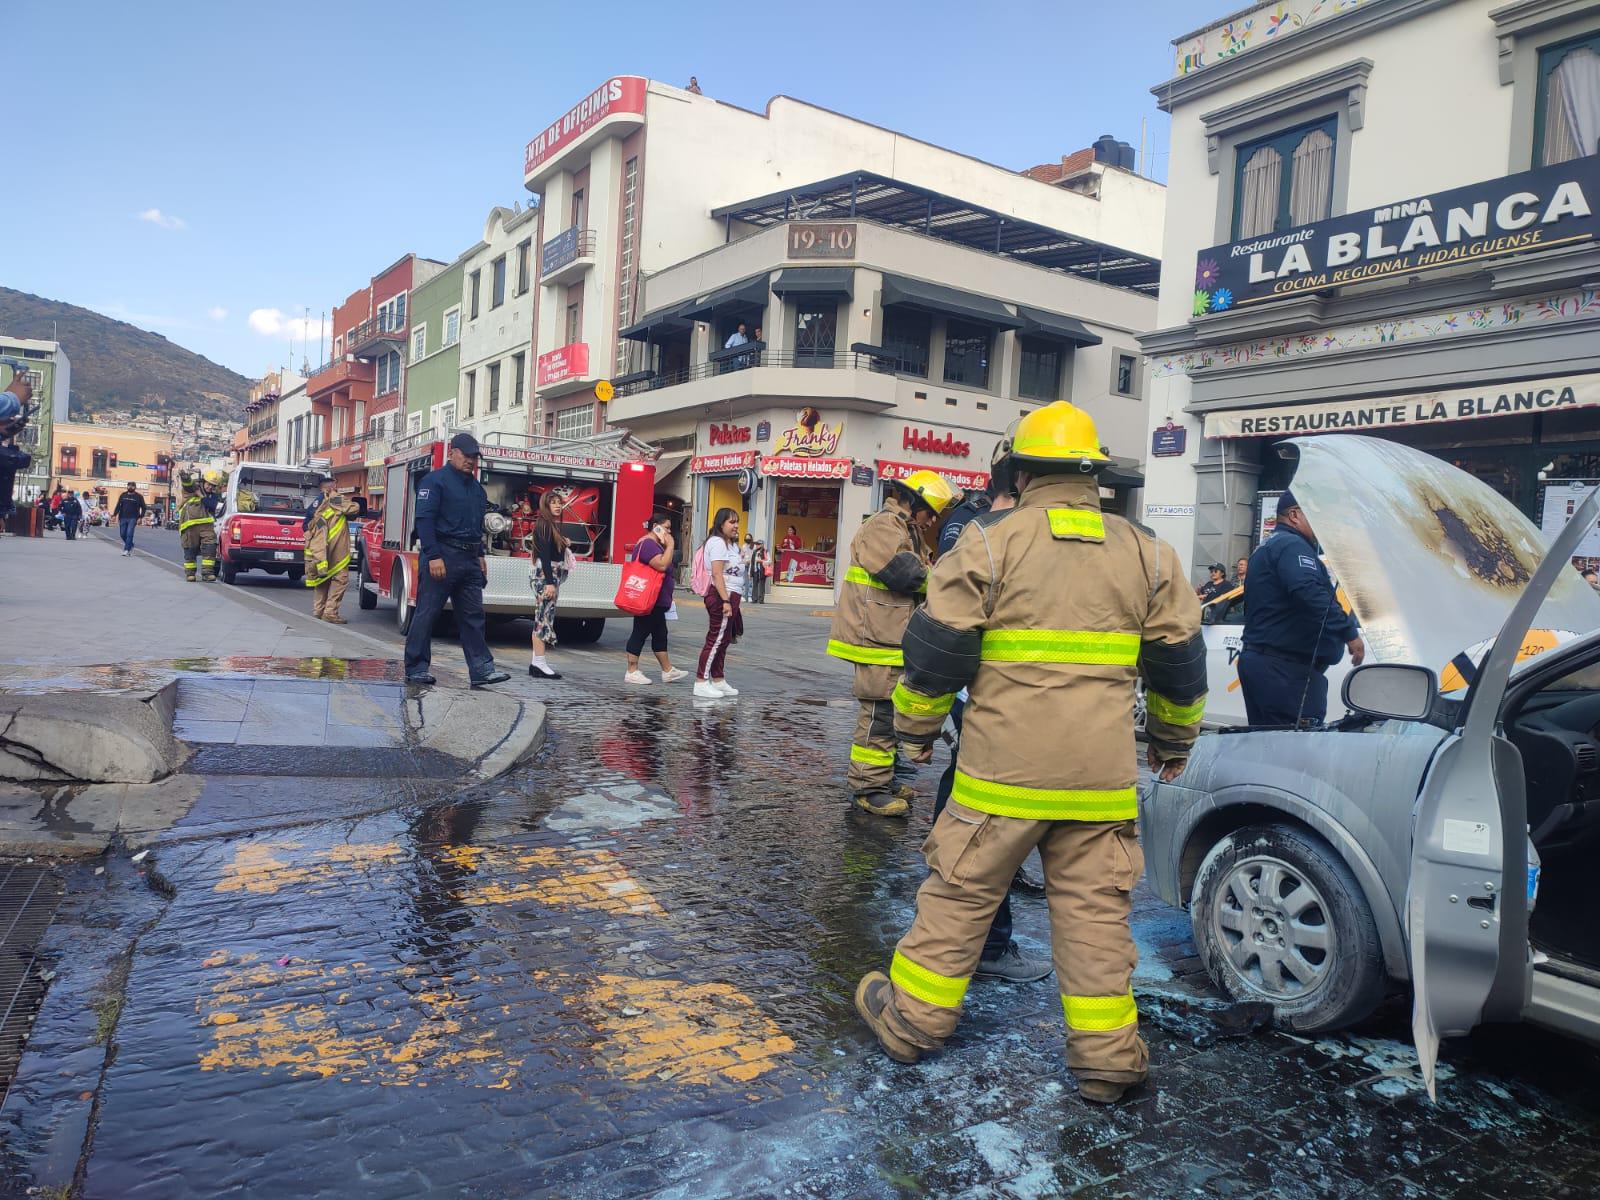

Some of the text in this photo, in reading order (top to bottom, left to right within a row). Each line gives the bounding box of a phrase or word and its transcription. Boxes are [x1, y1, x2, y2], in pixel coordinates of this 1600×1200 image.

[548, 121, 561, 147] DE
[563, 79, 622, 136] OFICINAS
[1374, 199, 1433, 224] MINA
[1230, 229, 1315, 258] Restaurante
[1249, 181, 1592, 284] LA BLANCA
[1273, 229, 1544, 293] COCINA REGIONAL HIDALGUENSE
[1241, 386, 1577, 434] RESTAURANTE LA BLANCA
[709, 423, 751, 446] Paletas
[783, 424, 837, 452] Franky
[903, 426, 970, 457] Helados
[480, 447, 500, 456] NIDAD
[502, 448, 525, 458] LIGERA
[526, 451, 553, 462] CONTRA
[553, 455, 587, 466] INCENDIOS
[704, 457, 720, 467] Paletas
[779, 461, 832, 473] Paletas y Helados
[1148, 506, 1194, 514] MATAMOROS
